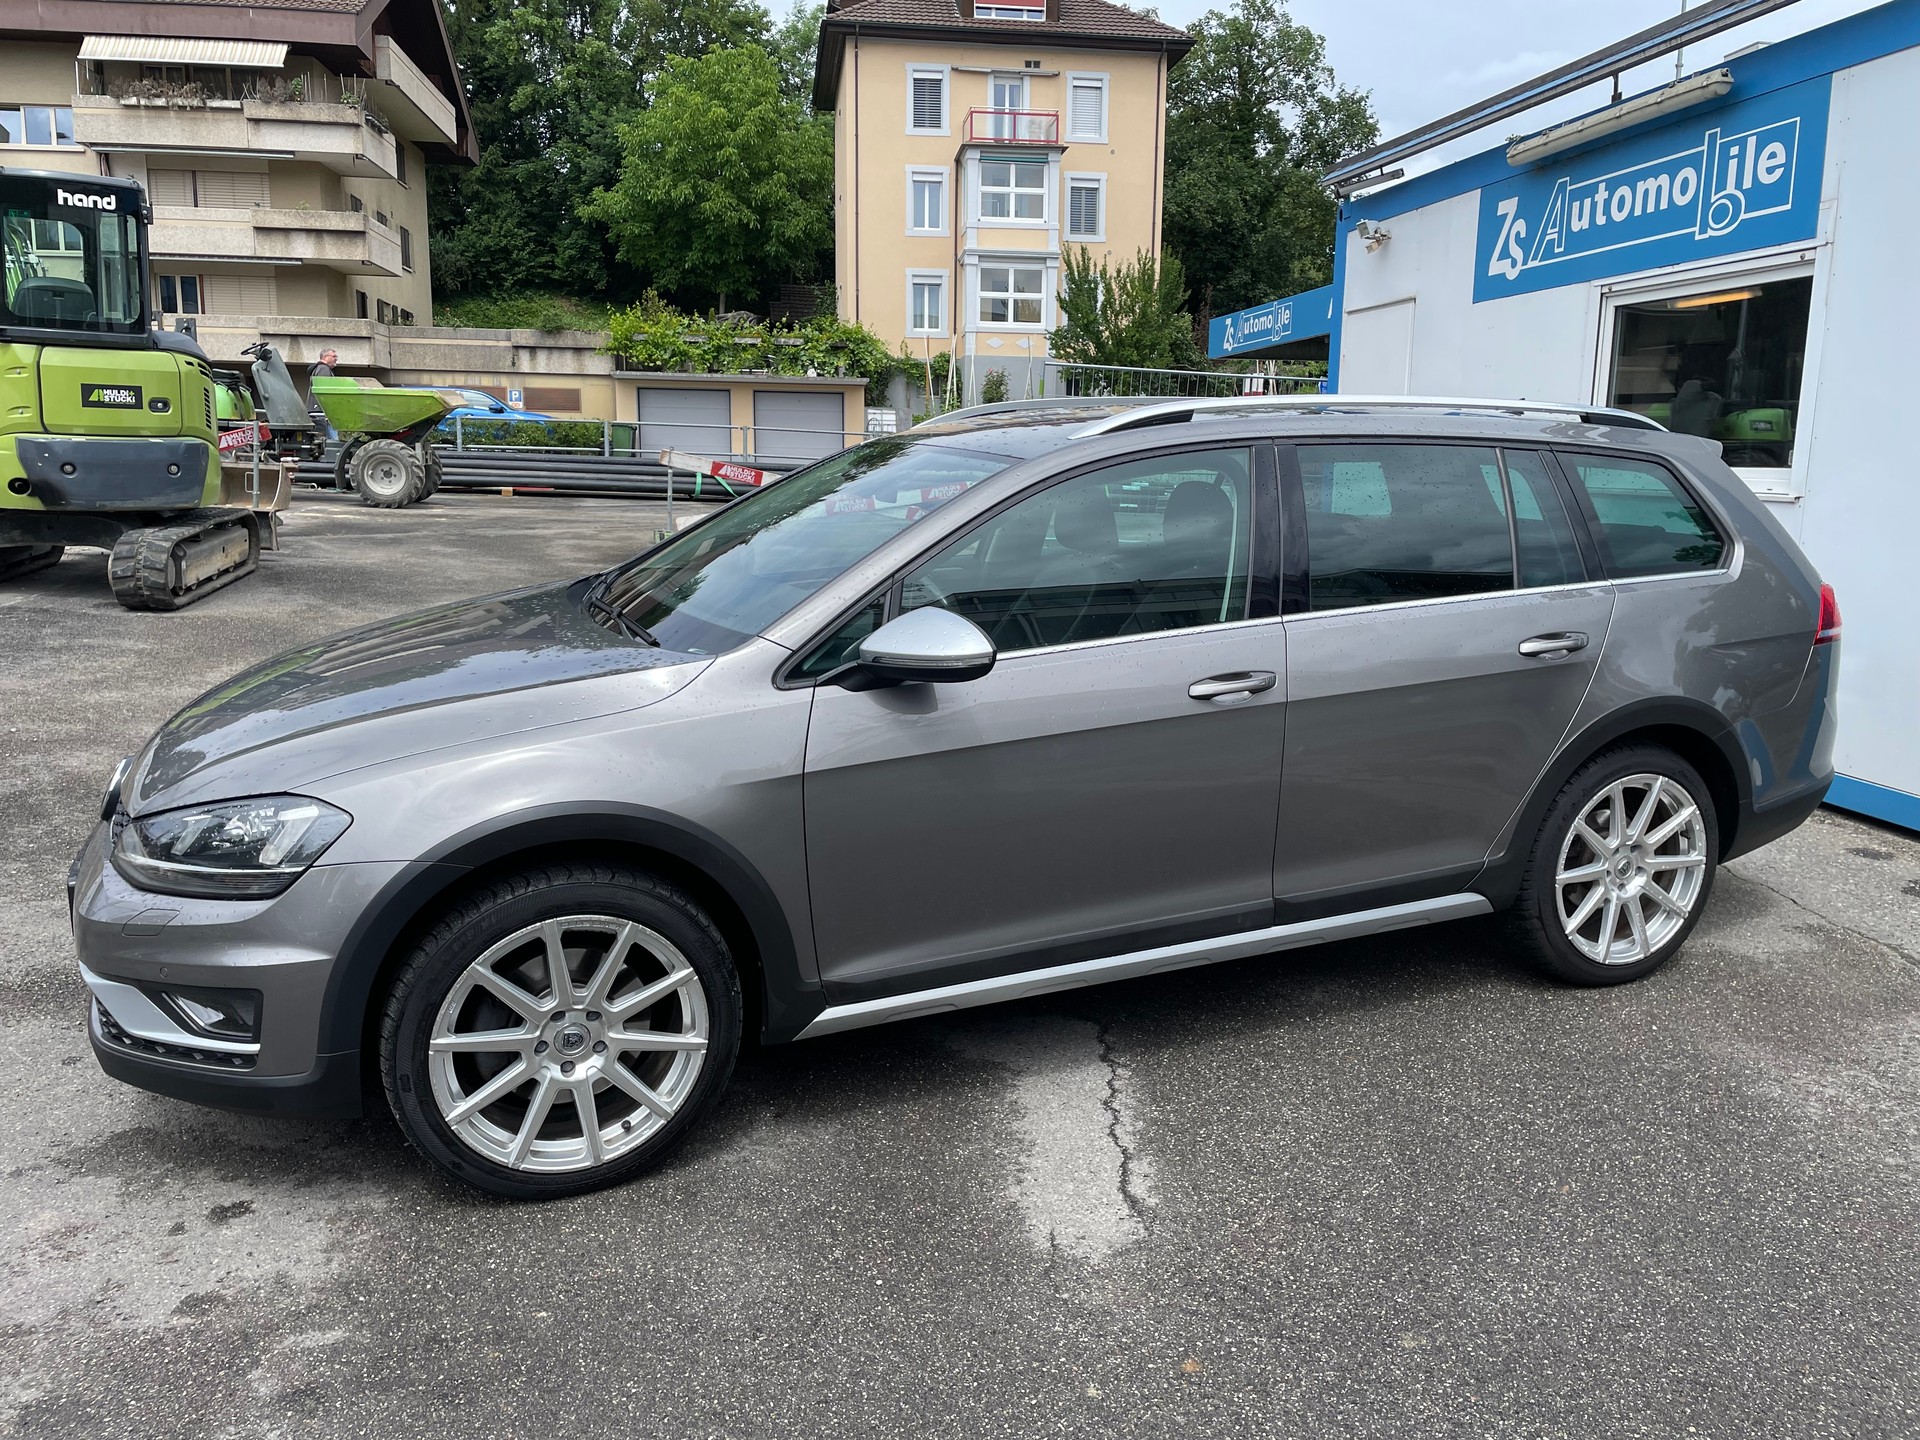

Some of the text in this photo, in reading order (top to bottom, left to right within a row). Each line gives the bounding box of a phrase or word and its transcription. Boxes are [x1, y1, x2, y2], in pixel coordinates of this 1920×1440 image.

[57, 189, 116, 210] hand
[1528, 127, 1787, 266] Automobile
[1234, 302, 1290, 346] Automobile
[512, 391, 519, 401] P
[232, 432, 262, 444] STUCI
[730, 471, 756, 482] STUCKI
